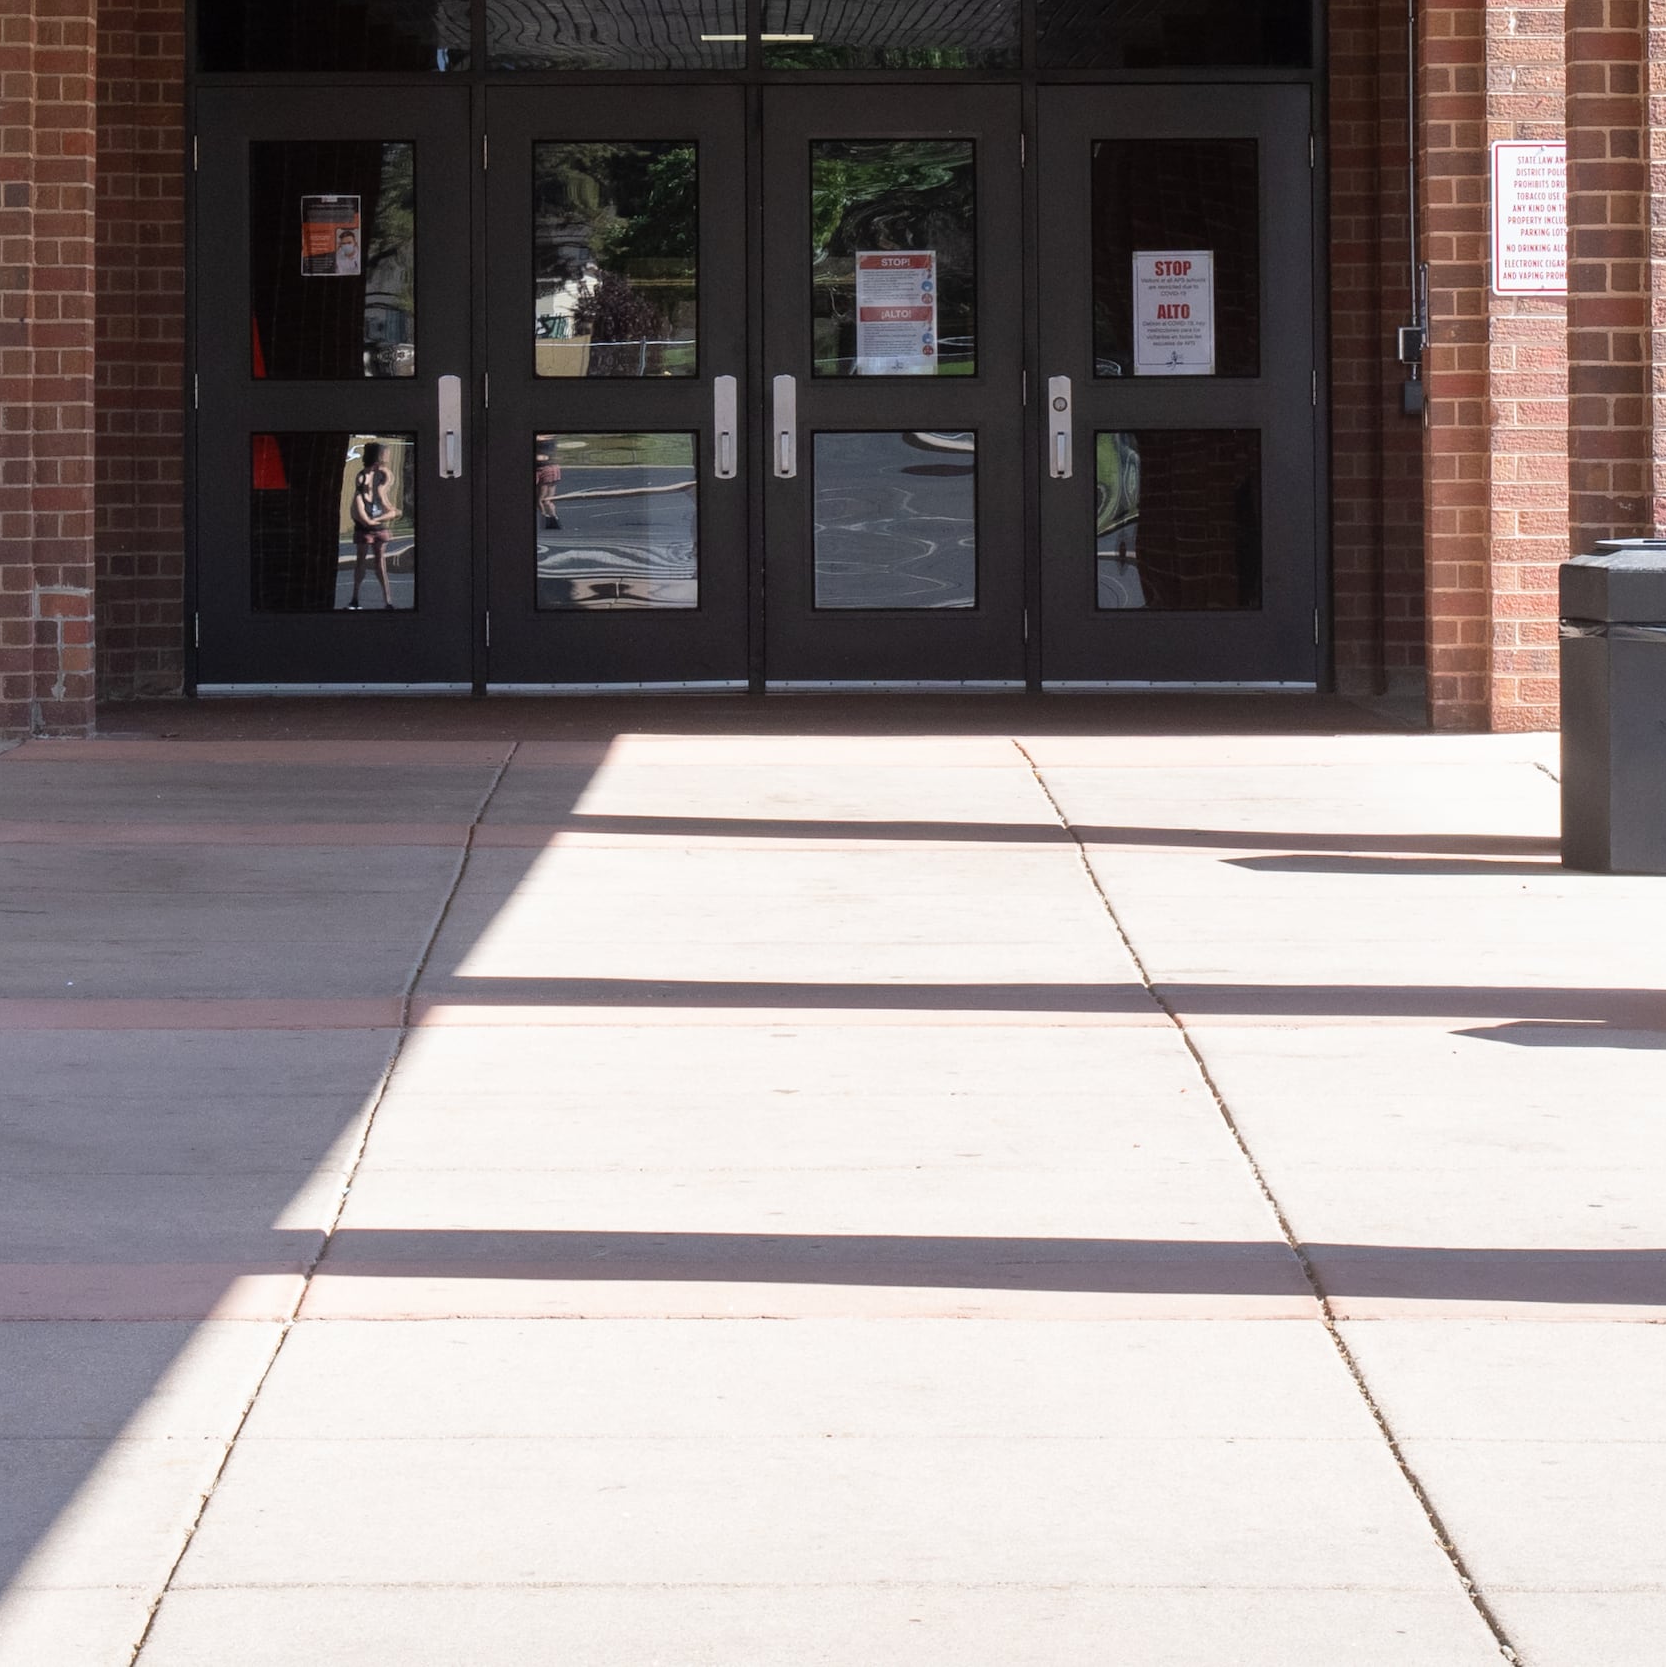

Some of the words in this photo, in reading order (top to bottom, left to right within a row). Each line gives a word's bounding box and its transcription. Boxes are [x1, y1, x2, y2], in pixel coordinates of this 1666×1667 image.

[1517, 156, 1536, 165] STATE
[1538, 156, 1552, 165] LAW
[1555, 156, 1564, 165] AN
[1516, 168, 1545, 176] DISTRICT
[1547, 168, 1566, 176] POLIC
[1513, 180, 1549, 188] PROHIBITS
[1551, 180, 1565, 188] DRU
[1517, 192, 1546, 201] TOBACCO
[1548, 192, 1559, 201] USE
[1512, 204, 1526, 212] ANY
[1529, 204, 1545, 212] KIND
[1546, 204, 1556, 212] ON
[1558, 204, 1566, 212] TH
[1508, 216, 1542, 224] PROPERTY
[1544, 216, 1567, 224] INCLU
[1520, 228, 1550, 236] PARKING
[1506, 244, 1516, 252] NO
[1517, 244, 1551, 252] DRINKING
[1553, 244, 1567, 252] ALC
[881, 258, 910, 266] STOP!
[1504, 259, 1543, 268] ELECTRONIC
[1545, 259, 1565, 268] CIGAR
[1155, 260, 1191, 276] STOP
[1502, 271, 1517, 280] AND
[1519, 271, 1544, 280] VAPING
[1545, 271, 1567, 280] PROH
[881, 309, 912, 320] ¡ALTO!
[1157, 304, 1190, 319] ALTO
